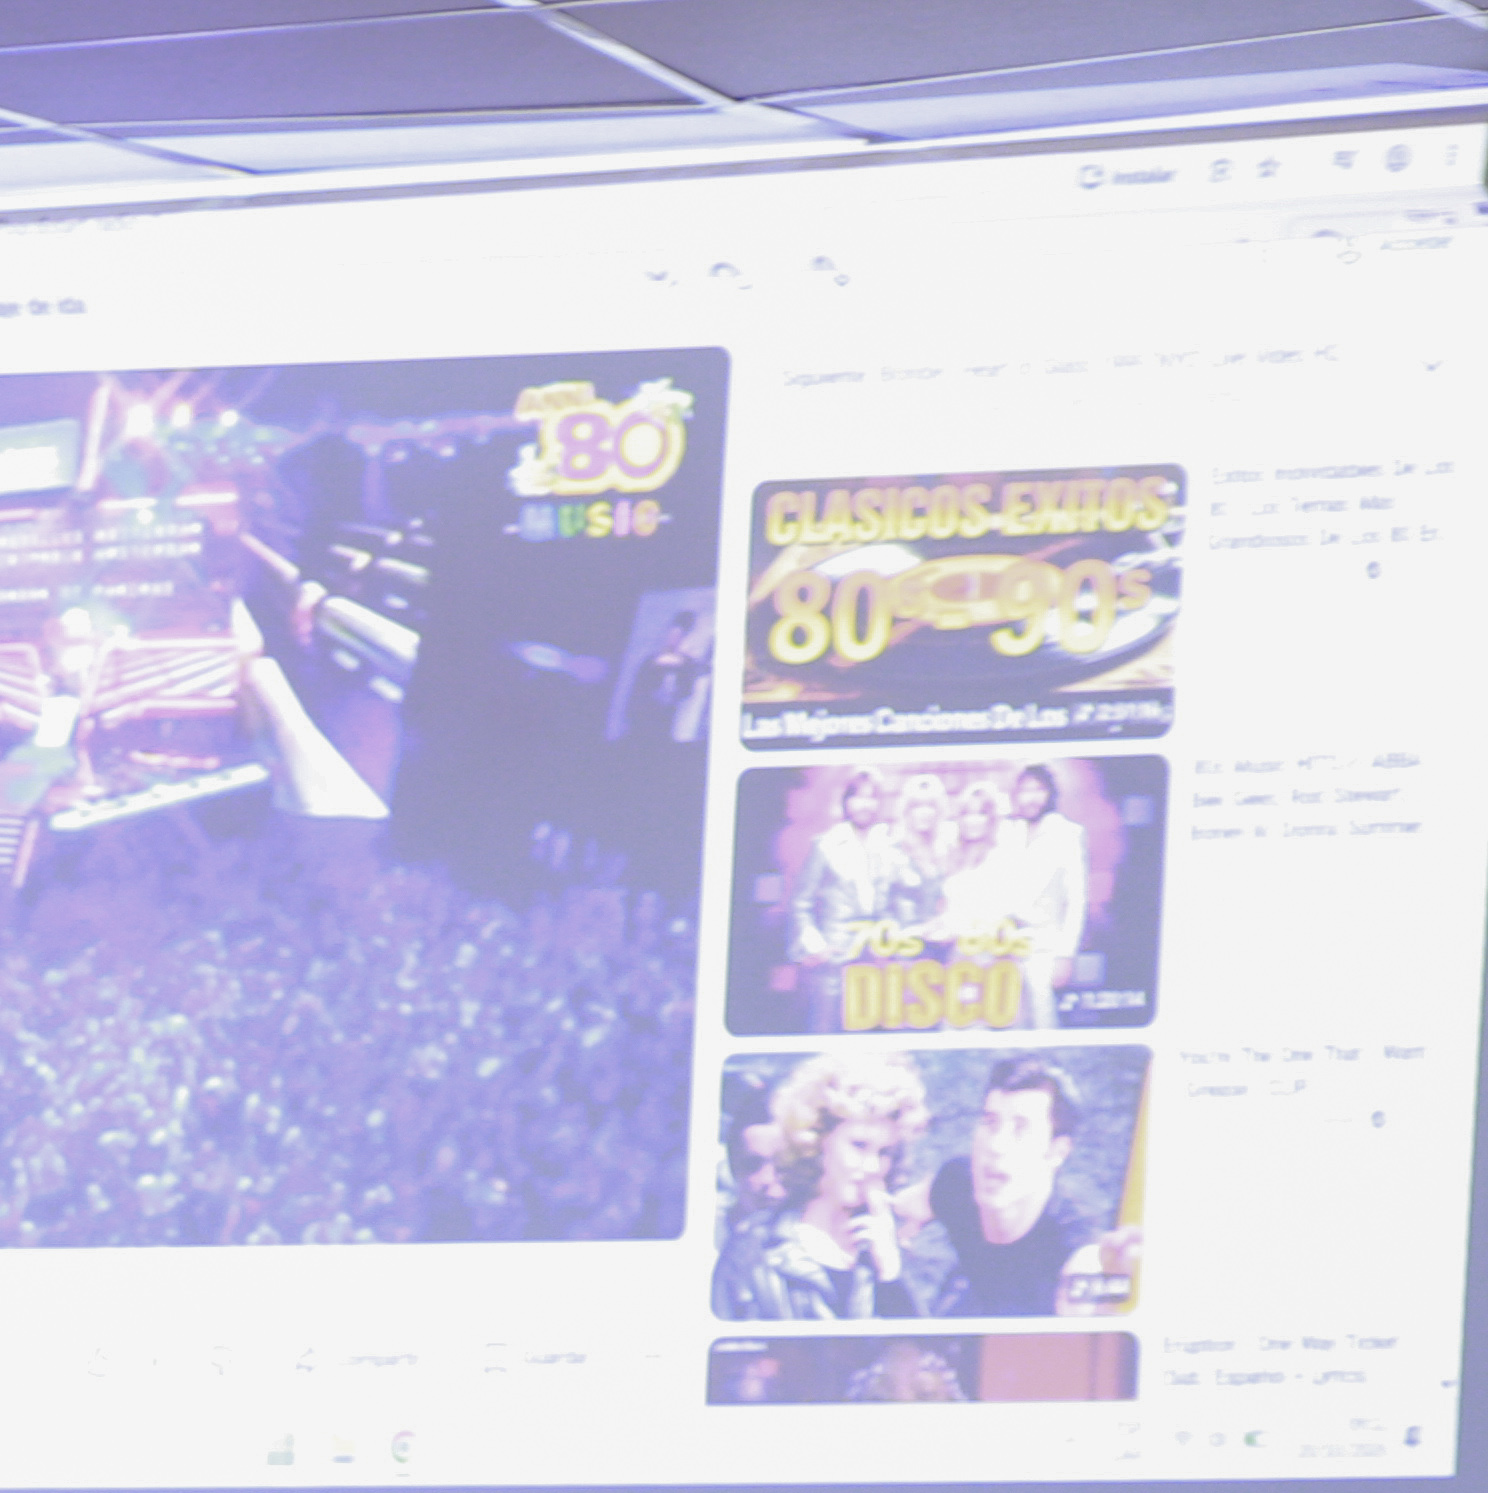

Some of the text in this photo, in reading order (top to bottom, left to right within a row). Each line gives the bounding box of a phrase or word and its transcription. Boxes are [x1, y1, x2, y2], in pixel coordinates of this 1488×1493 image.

[546, 403, 680, 489] 80
[518, 499, 660, 541] MUSIC
[765, 476, 1170, 546] CLASICOS EXITOS
[742, 714, 782, 739] Las
[784, 708, 873, 743] Mejores
[874, 704, 991, 735] Canciones
[992, 703, 1025, 732] De
[1026, 703, 1069, 730] Los
[842, 959, 1023, 1032] DISCO
